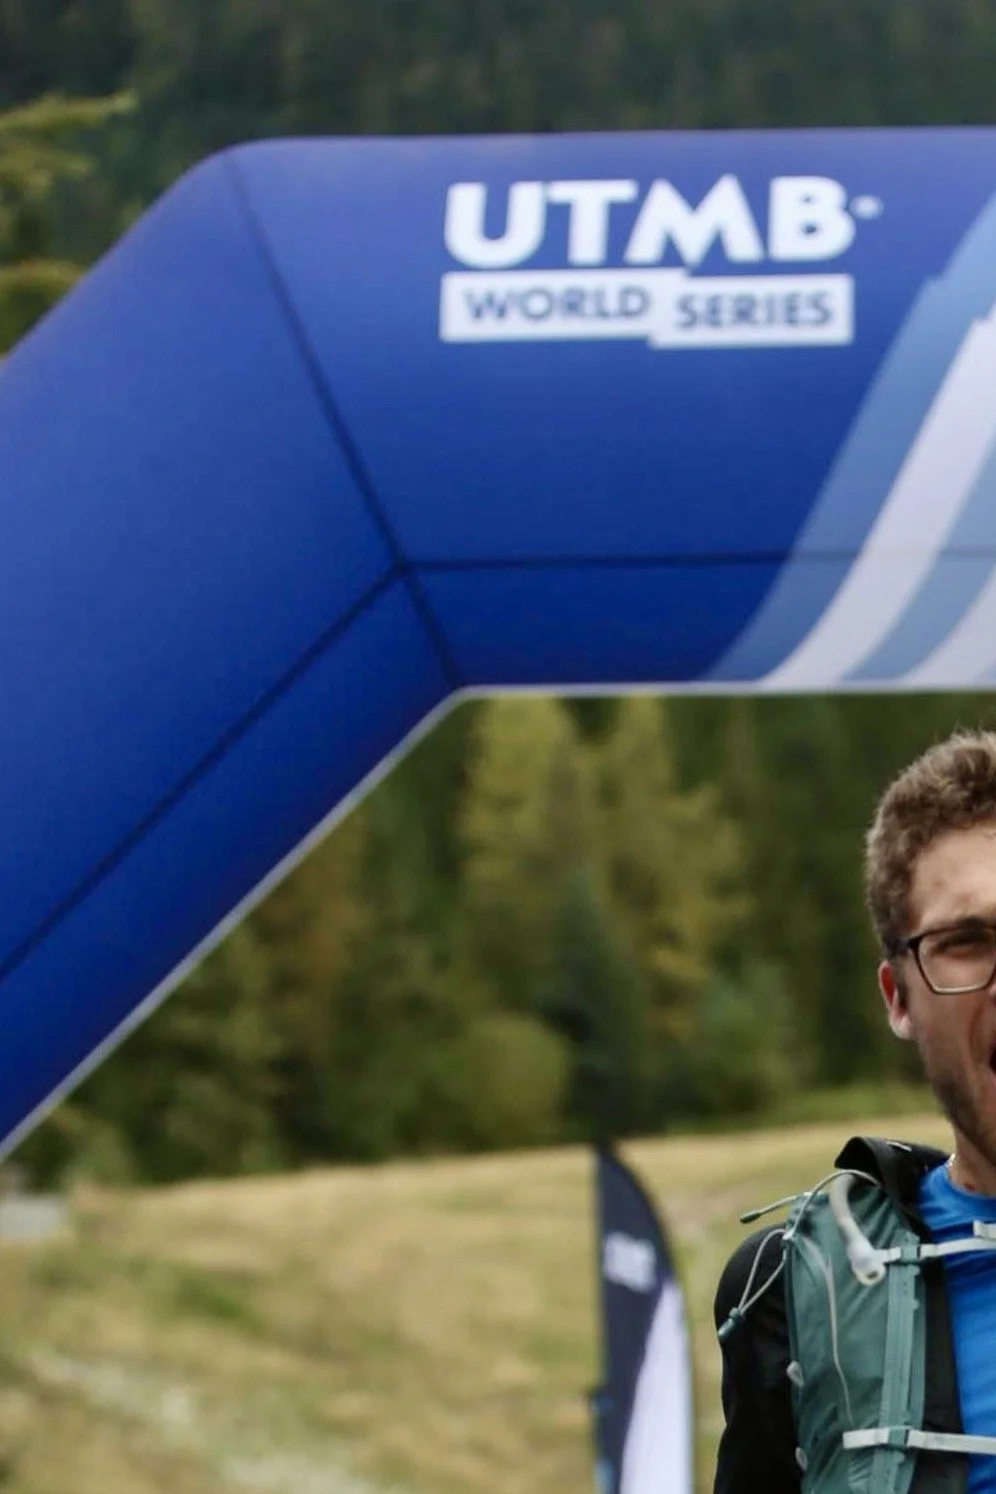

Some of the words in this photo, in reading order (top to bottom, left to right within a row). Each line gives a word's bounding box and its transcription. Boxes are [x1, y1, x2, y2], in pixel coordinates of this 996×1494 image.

[443, 173, 857, 269] UTMB
[463, 285, 650, 323] WORLD
[674, 290, 834, 330] SERIES
